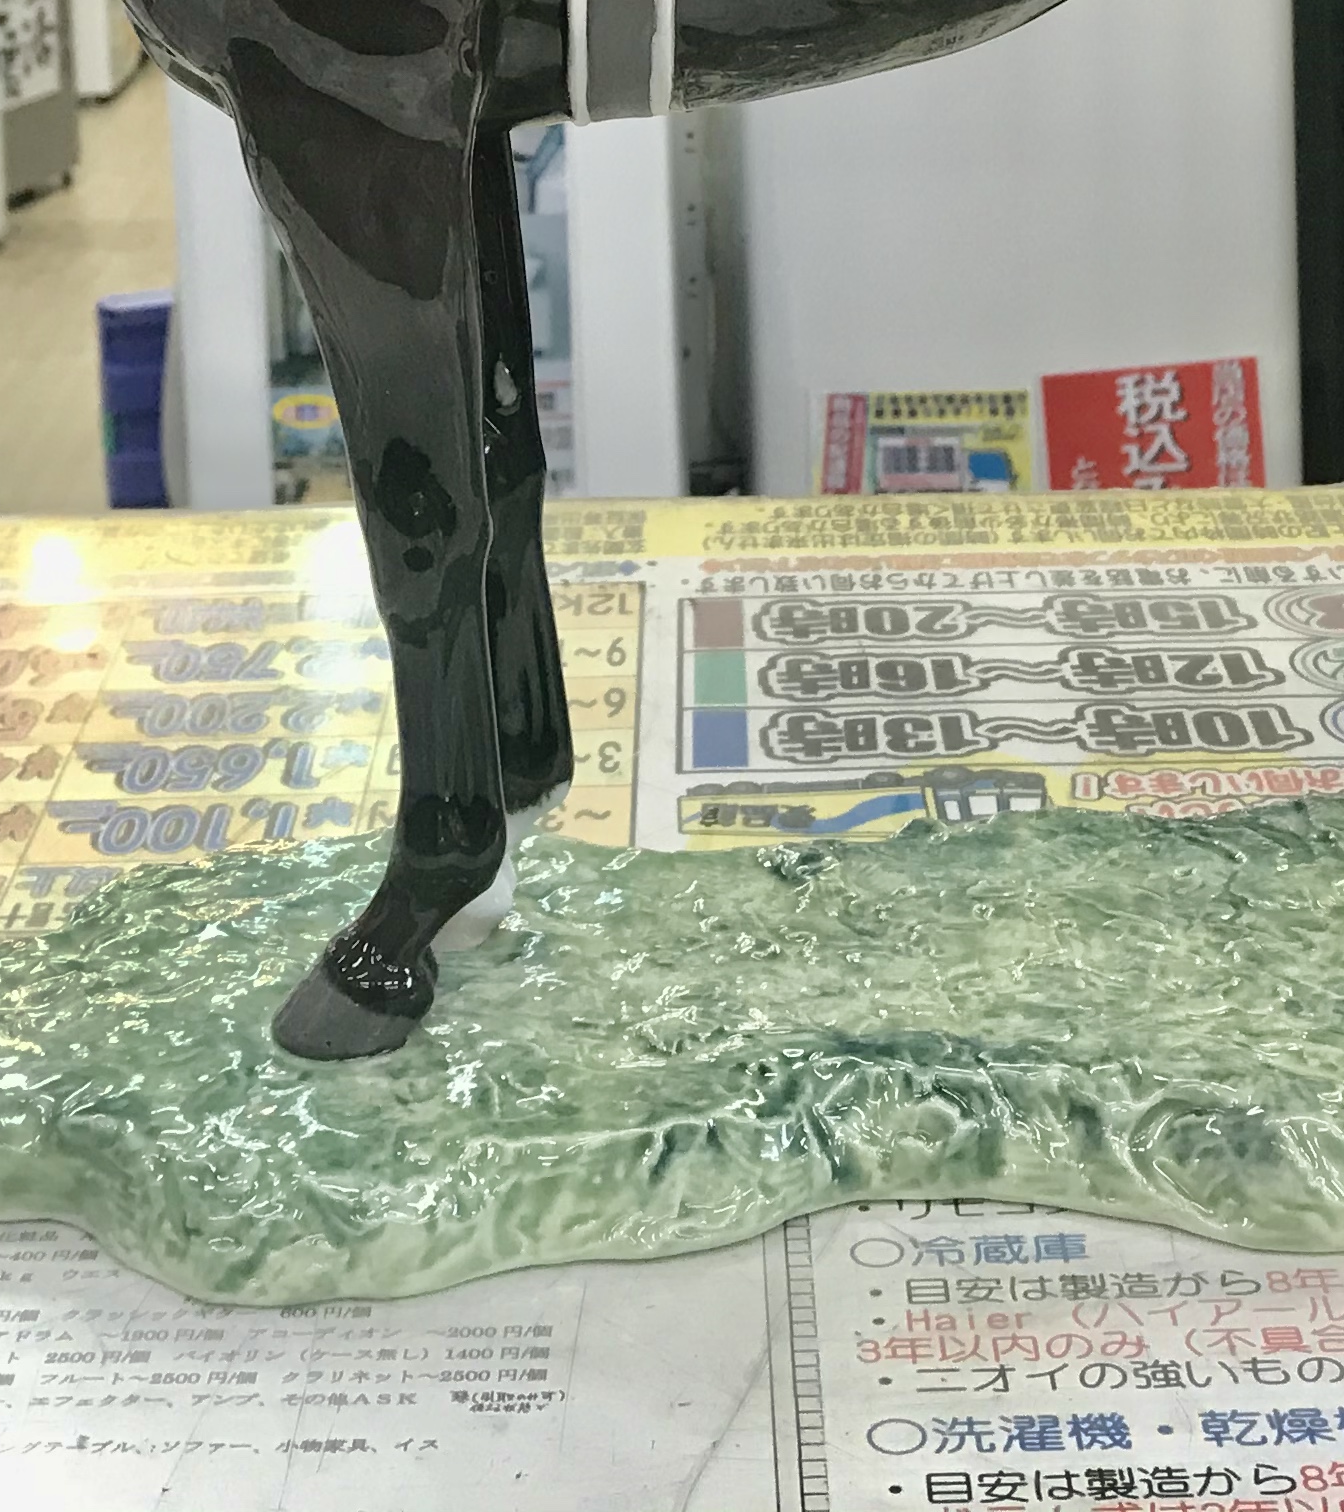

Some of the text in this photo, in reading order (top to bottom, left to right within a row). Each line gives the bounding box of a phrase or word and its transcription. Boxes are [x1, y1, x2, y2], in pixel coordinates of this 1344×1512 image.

[1115, 369, 1191, 489] 税込
[558, 592, 634, 616] 12k
[762, 594, 1248, 640] 15時～20時
[769, 646, 1274, 695] 12時～16時
[769, 704, 1304, 758] 10時～13時
